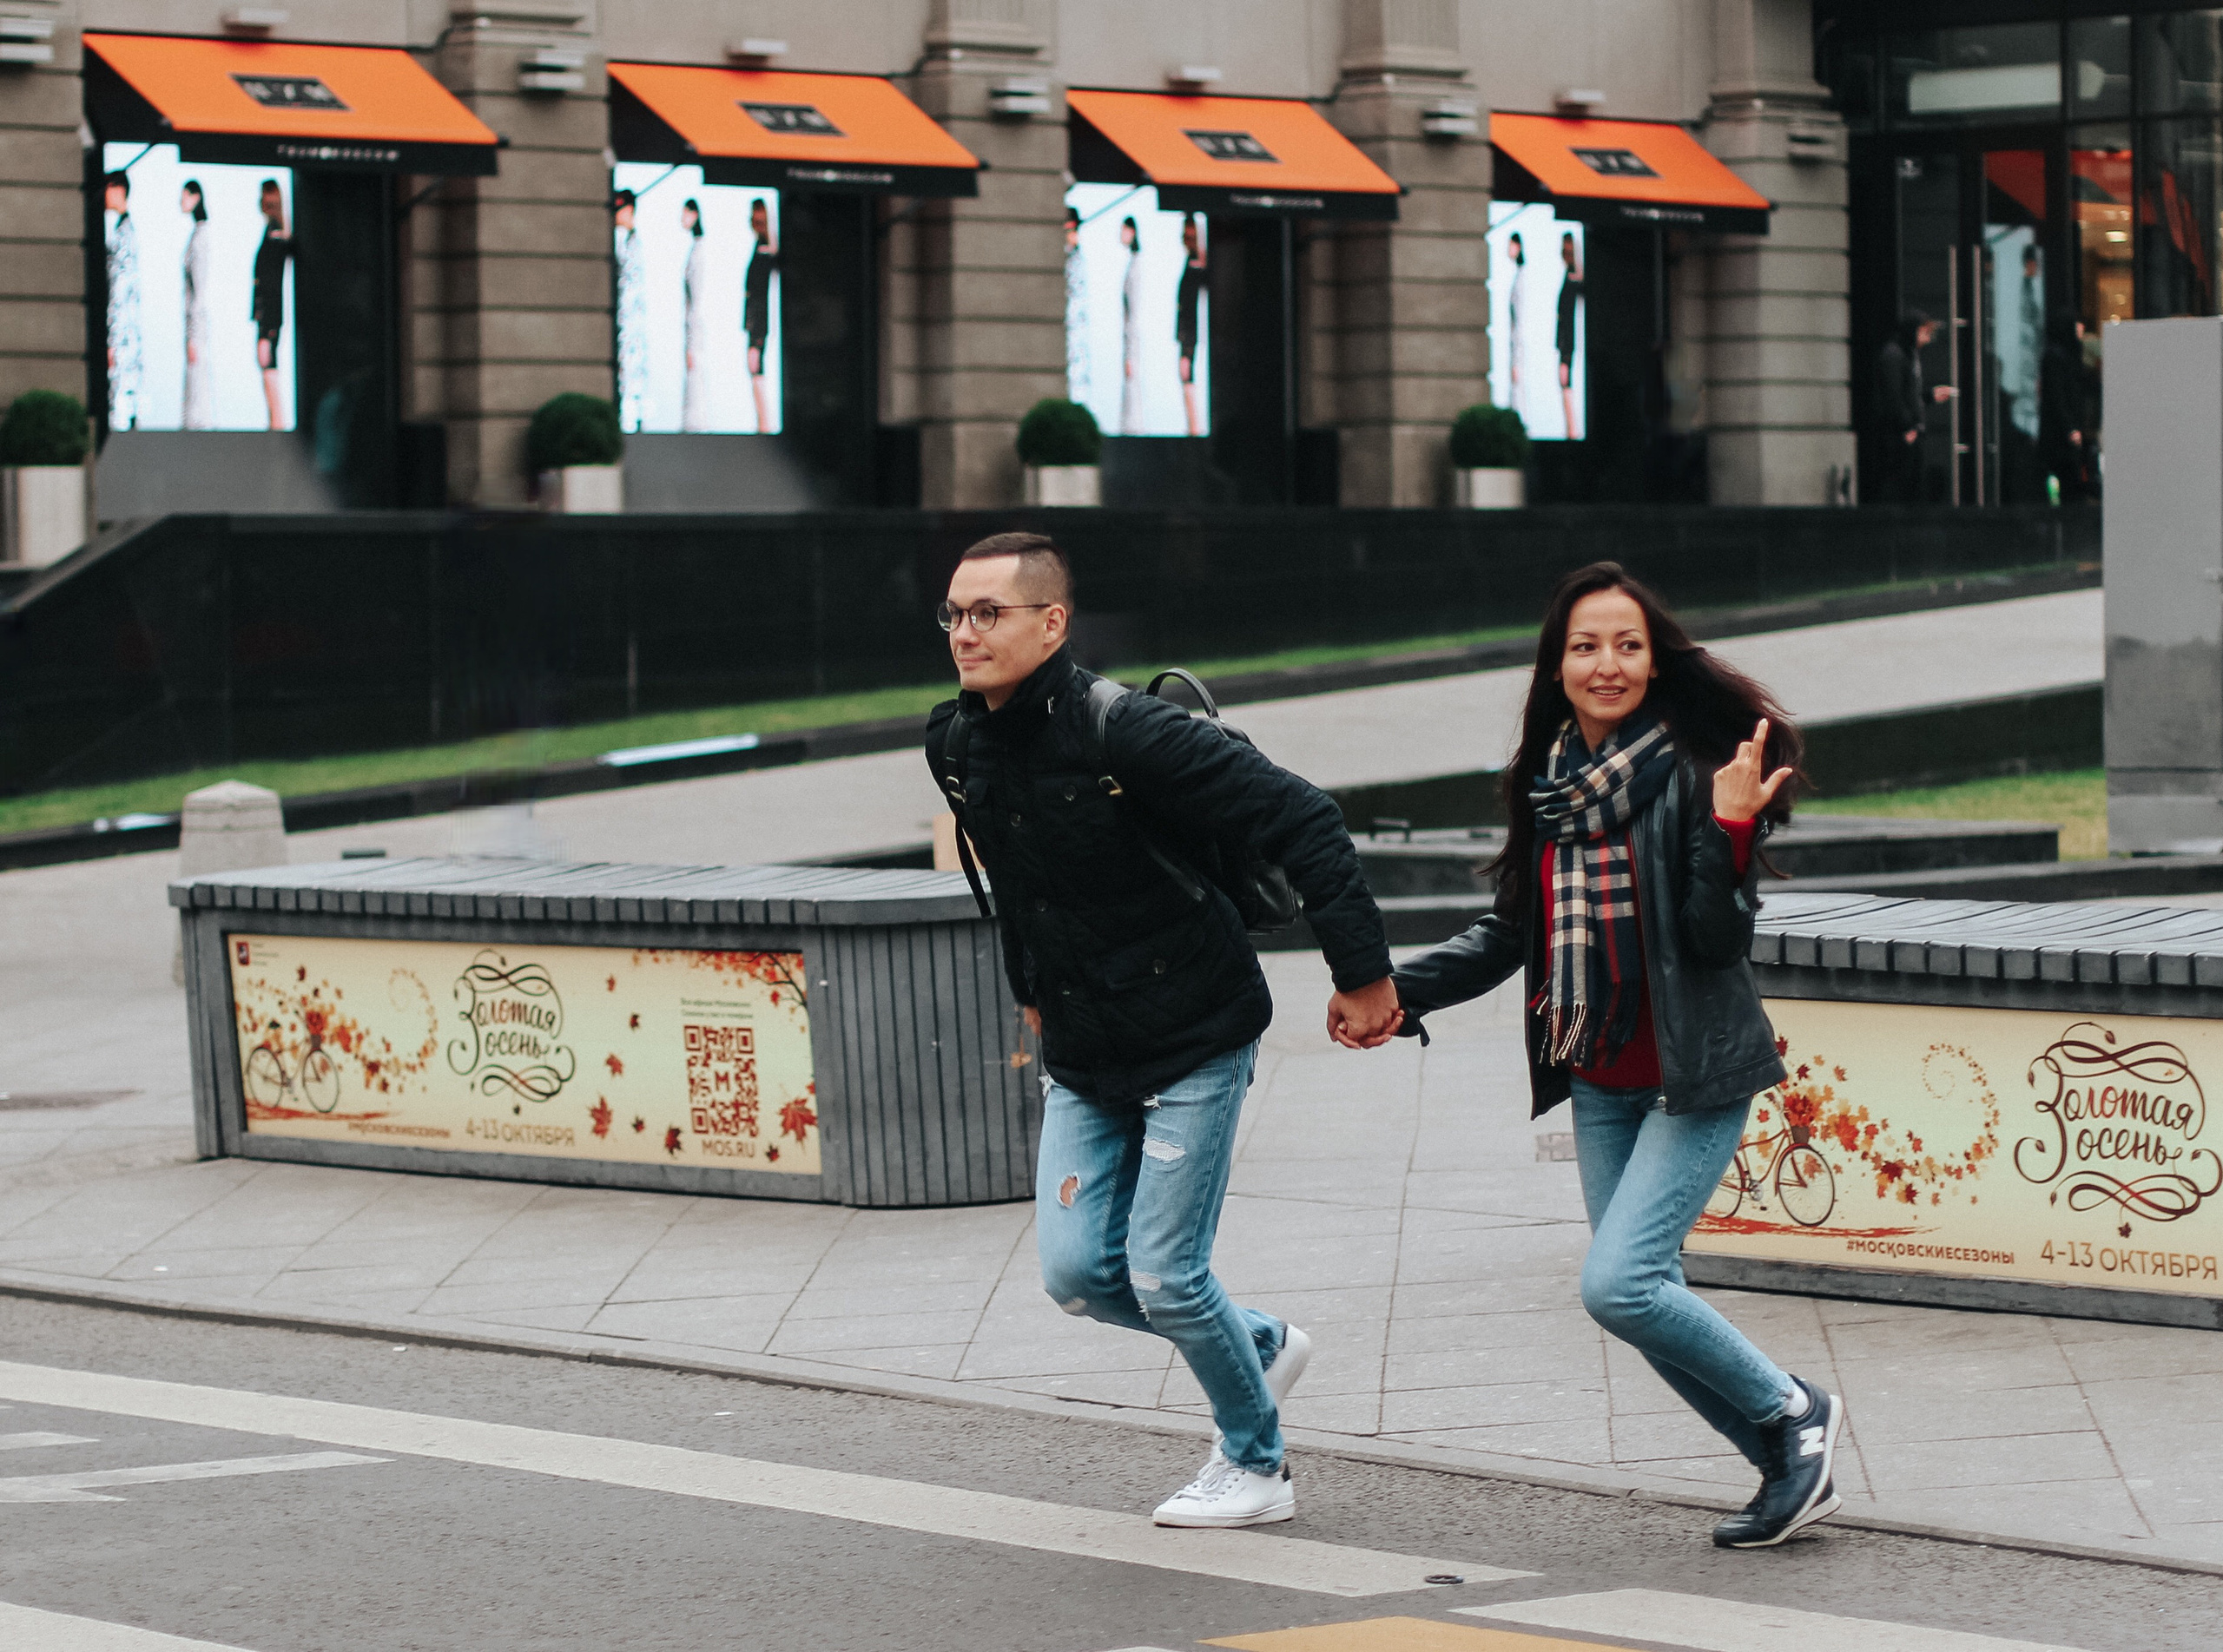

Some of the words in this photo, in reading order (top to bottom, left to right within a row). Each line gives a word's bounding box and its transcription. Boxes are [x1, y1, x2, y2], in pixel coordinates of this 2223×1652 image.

[465, 1117, 498, 1140] 4-13
[502, 1122, 575, 1146] ОКТЯБРЯ
[2076, 1127, 2183, 1165] осень
[702, 1139, 755, 1158] MOS.RU
[1846, 1240, 2015, 1264] #МОСКОВСКИЕСЕЗОНЫ
[2041, 1239, 2094, 1268] 4-13
[2100, 1247, 2218, 1280] ОКТЯБРЯ
